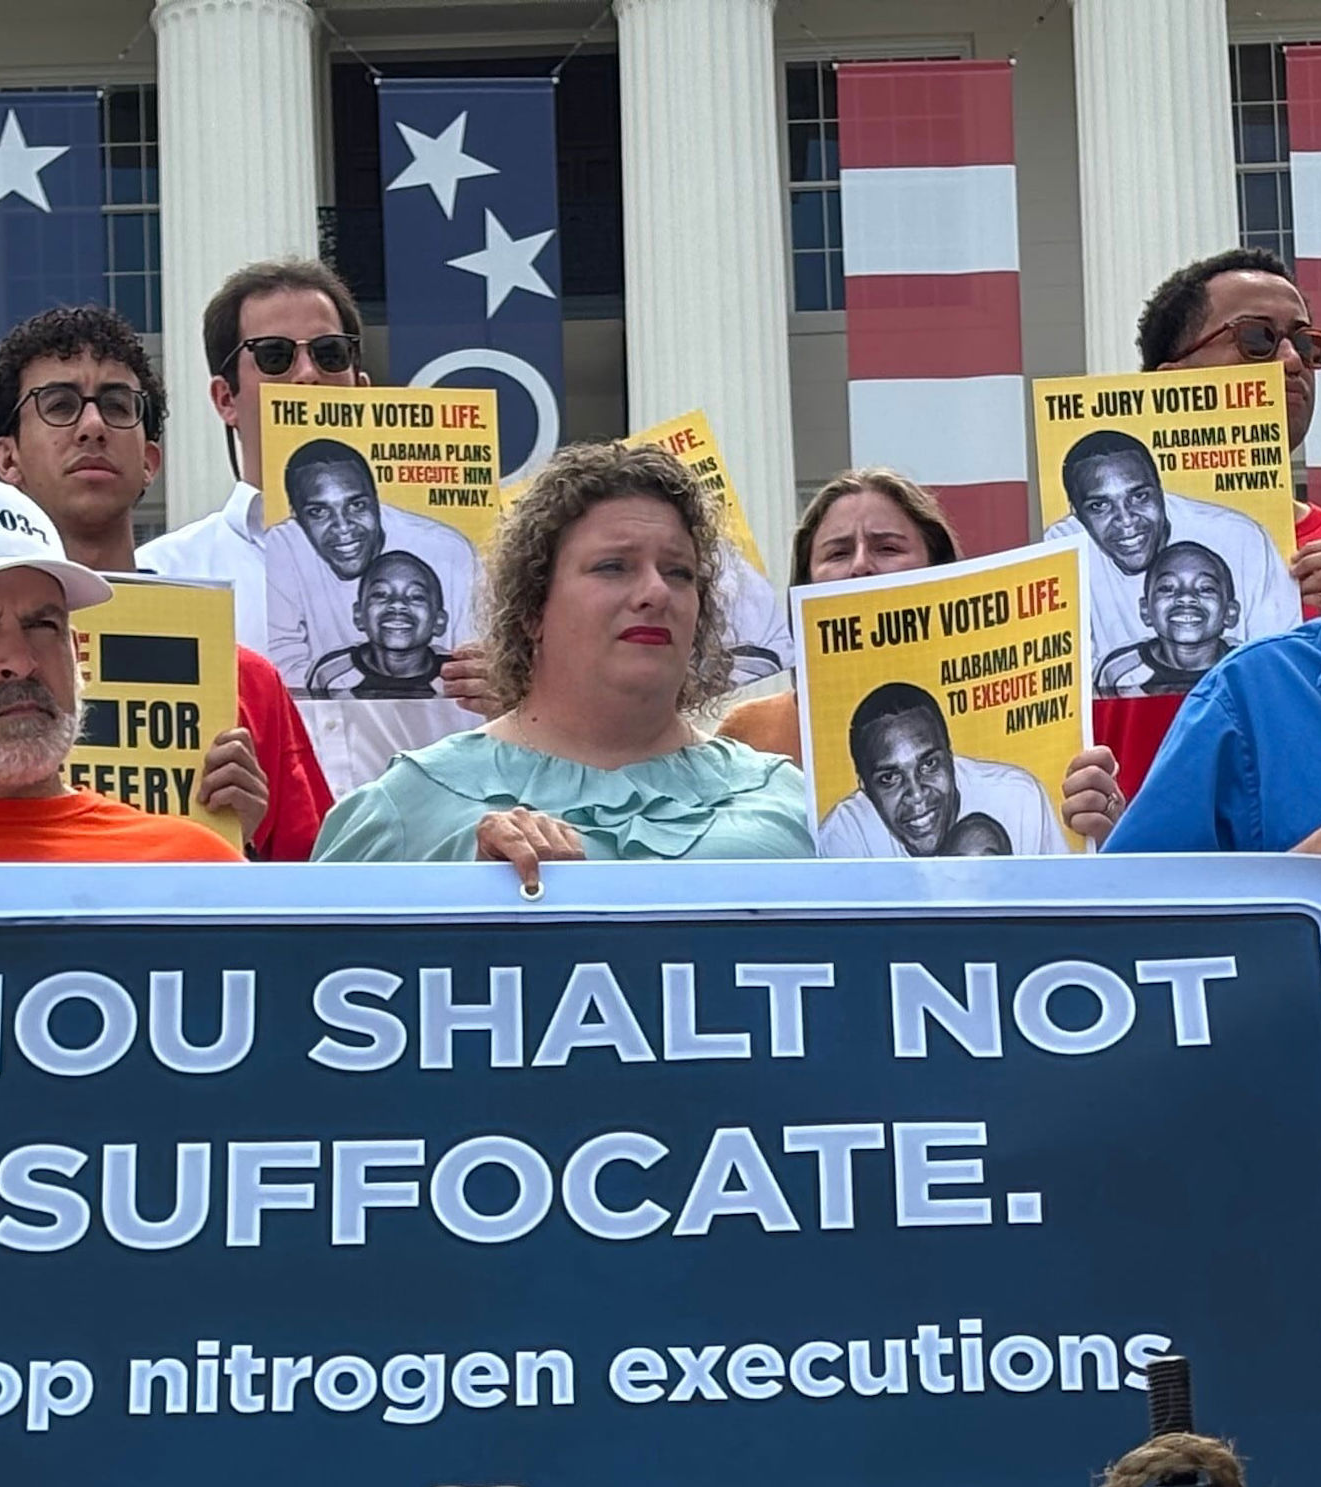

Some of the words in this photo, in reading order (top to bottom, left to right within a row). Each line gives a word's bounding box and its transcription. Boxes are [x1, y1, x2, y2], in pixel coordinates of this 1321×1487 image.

[272, 401, 307, 426] THE
[314, 403, 364, 427] JURY
[372, 404, 434, 428] VOTED
[440, 405, 487, 430] LIFE.
[1045, 394, 1084, 420] THE
[1091, 391, 1144, 417] JURY
[1152, 385, 1218, 415] VOTED
[1224, 381, 1275, 409] LIFE.
[370, 443, 441, 462] ALABAMA
[446, 444, 491, 462] PLANS
[658, 428, 705, 455] IFE.
[1152, 427, 1227, 448] ALABAMA
[1231, 424, 1280, 445] PLANS
[376, 466, 394, 484] TO
[398, 466, 459, 484] EXECUTE
[464, 467, 492, 485] HIM
[1159, 453, 1177, 472] TO
[1182, 450, 1246, 470] EXECUTE
[1251, 447, 1281, 466] HIM
[428, 489, 494, 507] ANYWAY.
[1214, 472, 1284, 492] ANYWAY.
[818, 617, 863, 654] THE
[871, 606, 931, 647] JURY
[939, 590, 1010, 635] VOTED
[1016, 578, 1067, 620] LIFE.
[940, 648, 1018, 685] ALABAMA
[1023, 632, 1073, 673] PLANS
[946, 690, 968, 717] TO
[972, 672, 1037, 712] EXECUTE
[1042, 661, 1073, 696] HIM
[127, 701, 200, 750] FOR
[1005, 698, 1073, 735] ANYWAY.
[307, 961, 835, 1072] SHALT
[889, 955, 1238, 1060] NOT
[127, 1340, 574, 1425] nitrogen
